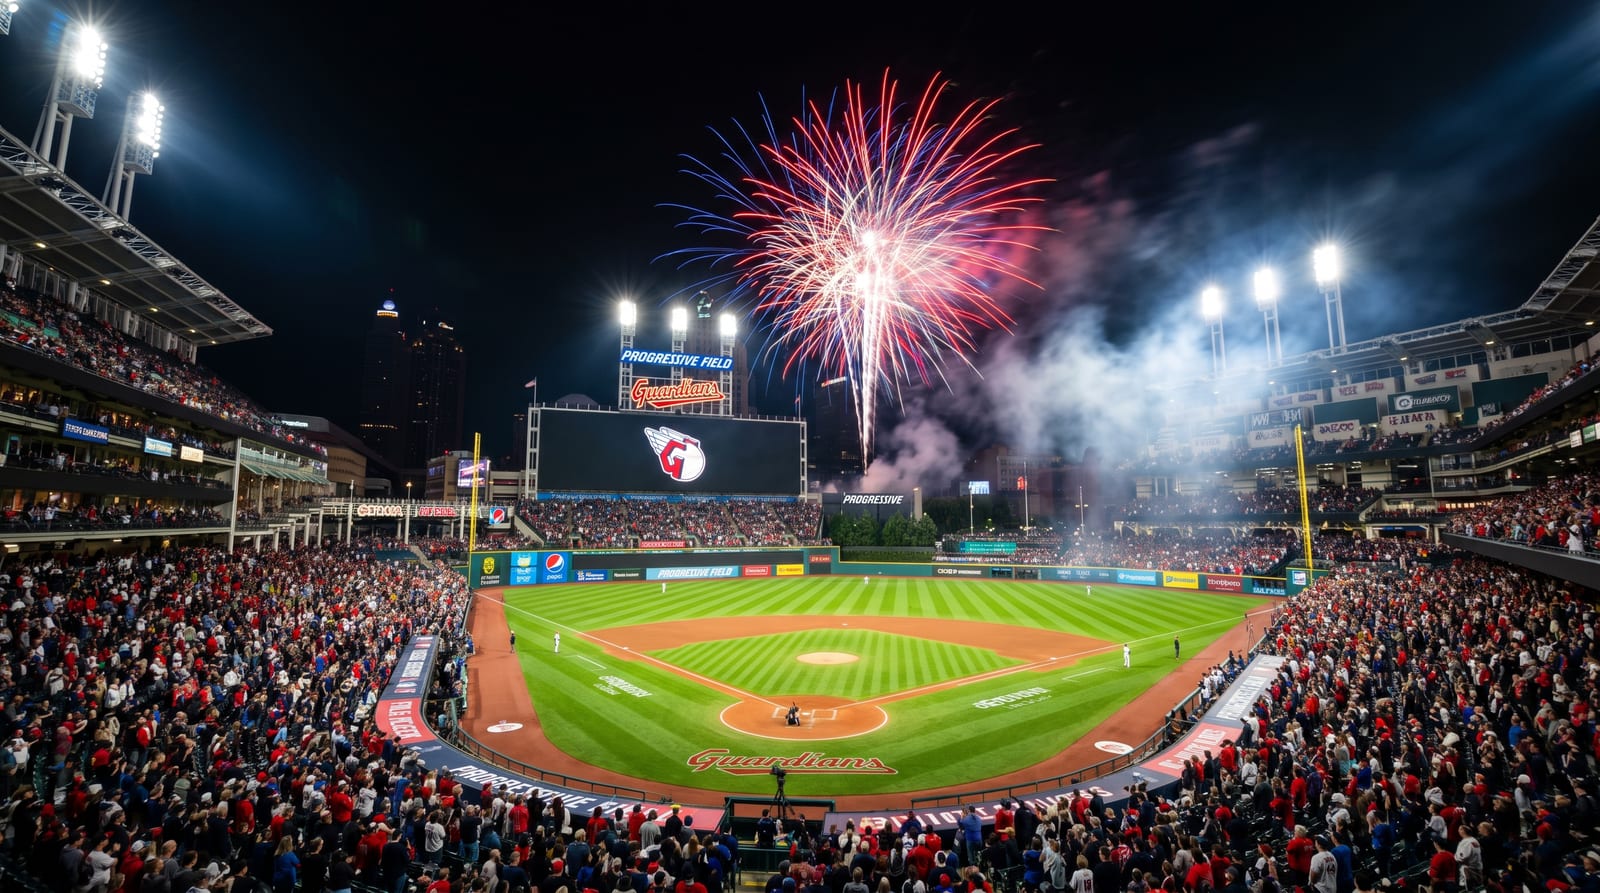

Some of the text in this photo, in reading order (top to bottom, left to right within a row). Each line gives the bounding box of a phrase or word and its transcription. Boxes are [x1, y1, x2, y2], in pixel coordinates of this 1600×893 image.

[621, 350, 733, 369] PROGRESSIVE FIELD
[632, 378, 726, 409] Guardians
[842, 494, 904, 505] PROGRESSIVE
[709, 567, 733, 576] FIELD
[687, 747, 899, 775] Guardians
